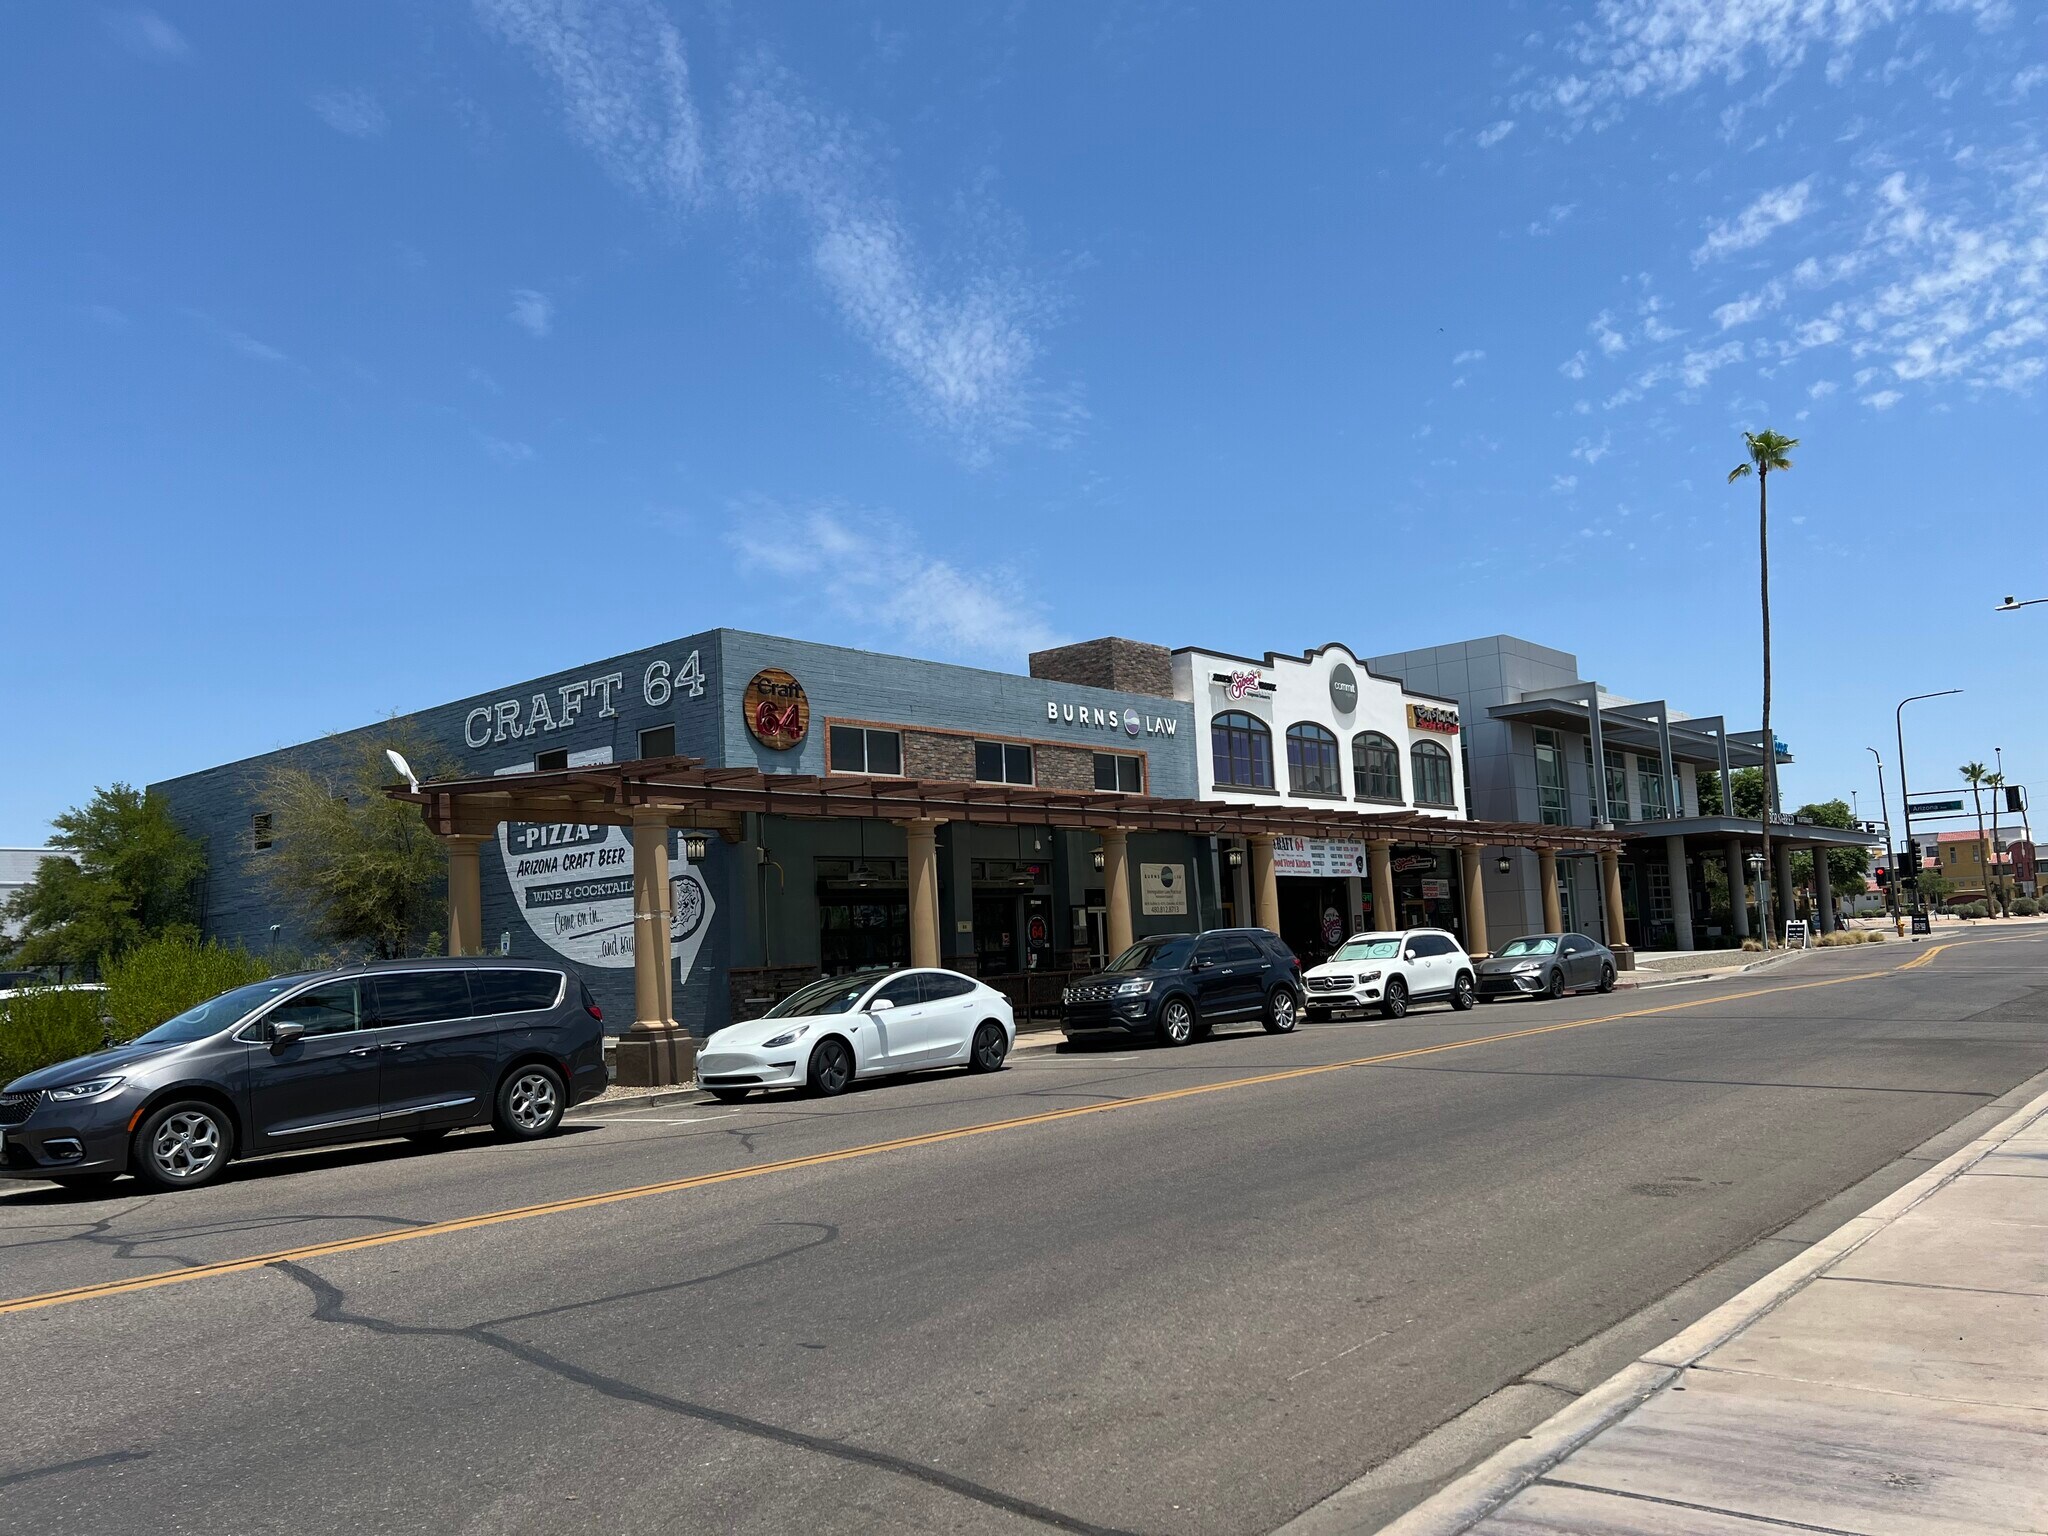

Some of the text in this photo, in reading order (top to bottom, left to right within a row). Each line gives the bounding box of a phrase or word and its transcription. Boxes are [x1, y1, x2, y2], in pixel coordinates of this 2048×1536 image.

[464, 649, 705, 749] CRAFT 64
[757, 678, 804, 699] Craft
[756, 701, 803, 739] 64
[1047, 701, 1177, 735] BURNS LAW
[1912, 804, 1939, 812] Arizona
[1295, 838, 1304, 851] 64
[516, 847, 626, 878] ARIZONA CRAFT BEER
[533, 889, 563, 902] WINE
[564, 888, 572, 899] &
[555, 912, 576, 935] Come
[577, 911, 588, 927] on
[1032, 926, 1043, 938] 64
